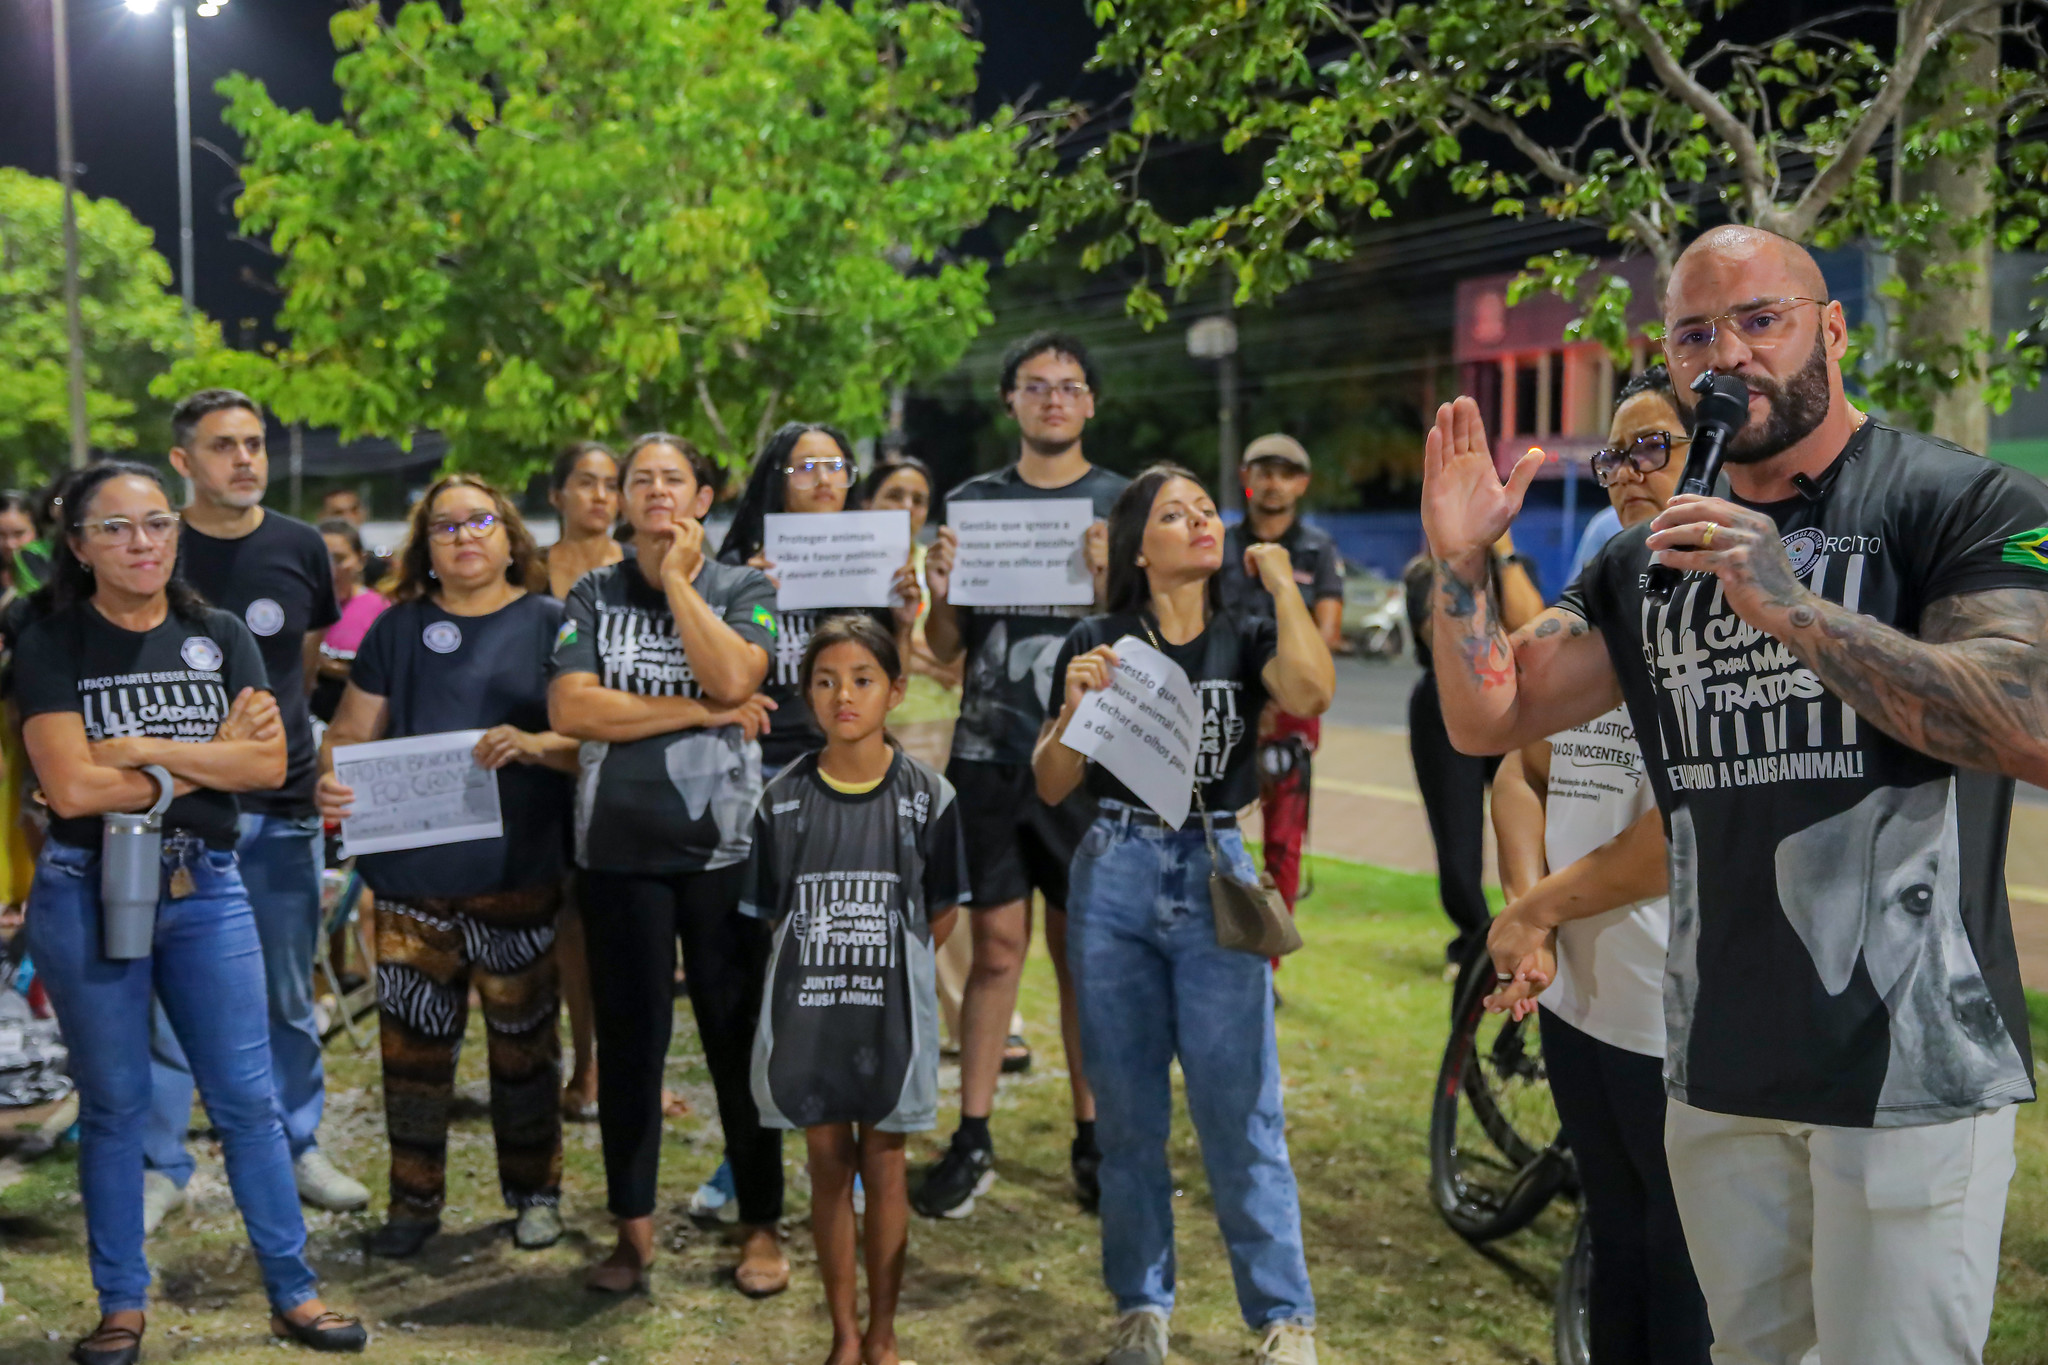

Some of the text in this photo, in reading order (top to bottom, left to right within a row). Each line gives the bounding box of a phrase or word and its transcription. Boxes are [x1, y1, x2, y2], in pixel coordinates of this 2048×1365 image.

[960, 521, 998, 531] Gestão
[1001, 522, 1021, 533] que
[1025, 519, 1060, 532] ignora
[778, 531, 875, 546] Proteger animais
[995, 539, 1031, 549] animal
[1034, 538, 1076, 549] escolhe
[812, 551, 842, 562] favor
[961, 556, 1072, 569] fechar os olhos para
[786, 569, 818, 580] dever
[971, 576, 990, 587] dor
[635, 661, 692, 682] TRATO
[1713, 654, 1750, 675] PARA
[114, 672, 151, 686] PARTE
[1119, 658, 1156, 690] Gestão
[1706, 669, 1824, 713] TRATOS
[139, 704, 219, 723] CADEIA
[1111, 682, 1138, 704] ausa
[1138, 701, 1176, 732] animal
[1084, 719, 1115, 743] a dor
[1095, 697, 1132, 727] fechar
[1130, 723, 1144, 738] os
[1143, 734, 1170, 759] olhos
[1562, 743, 1574, 755] OS
[1720, 762, 1731, 788] A
[1589, 780, 1623, 794] Protetores
[829, 900, 887, 919] CADEIA
[829, 930, 888, 946] TRATOS
[802, 974, 884, 990] JUNTOS PELA
[798, 989, 885, 1007] CAUSA ANIMAL
